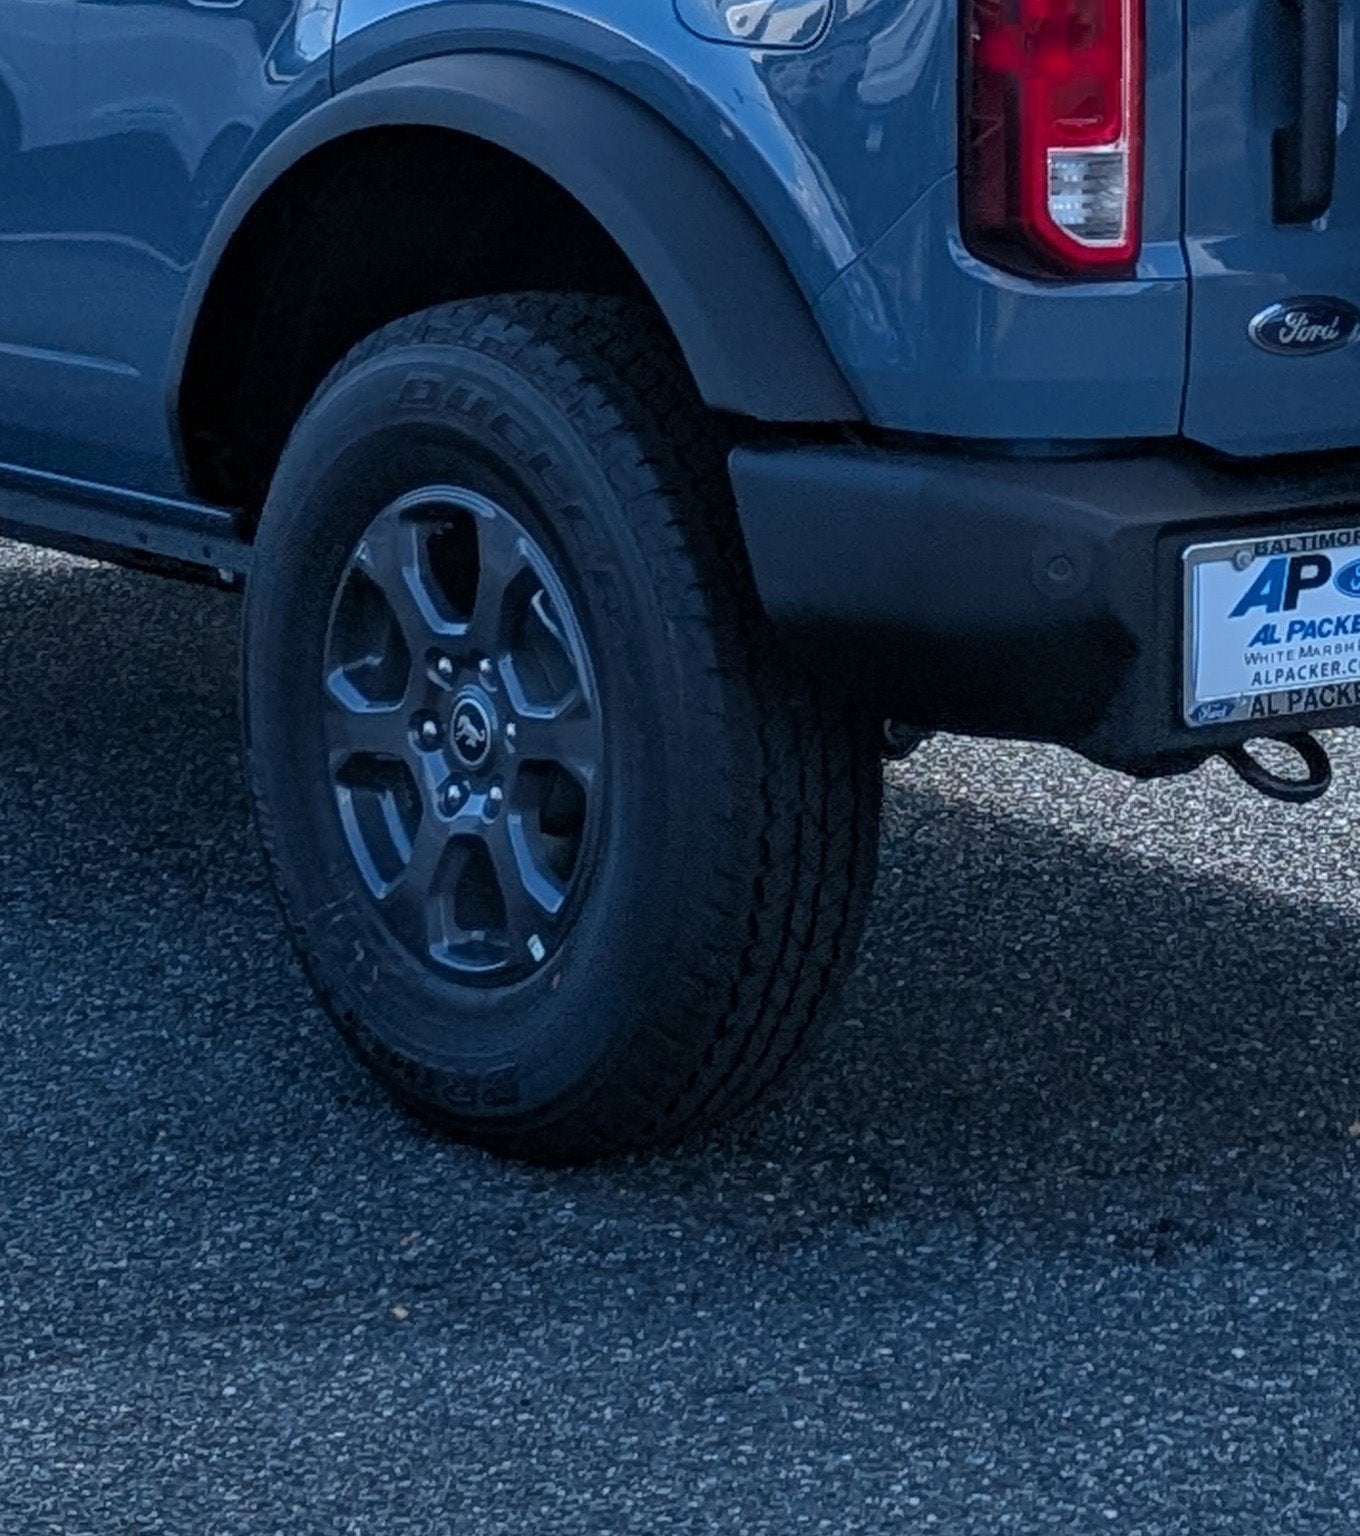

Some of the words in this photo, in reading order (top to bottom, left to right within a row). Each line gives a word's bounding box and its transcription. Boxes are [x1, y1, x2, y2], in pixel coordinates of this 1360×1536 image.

[1279, 312, 1339, 344] Ford
[1248, 623, 1281, 648] AL
[1244, 647, 1294, 666] WHITE
[1250, 693, 1281, 718] AL
